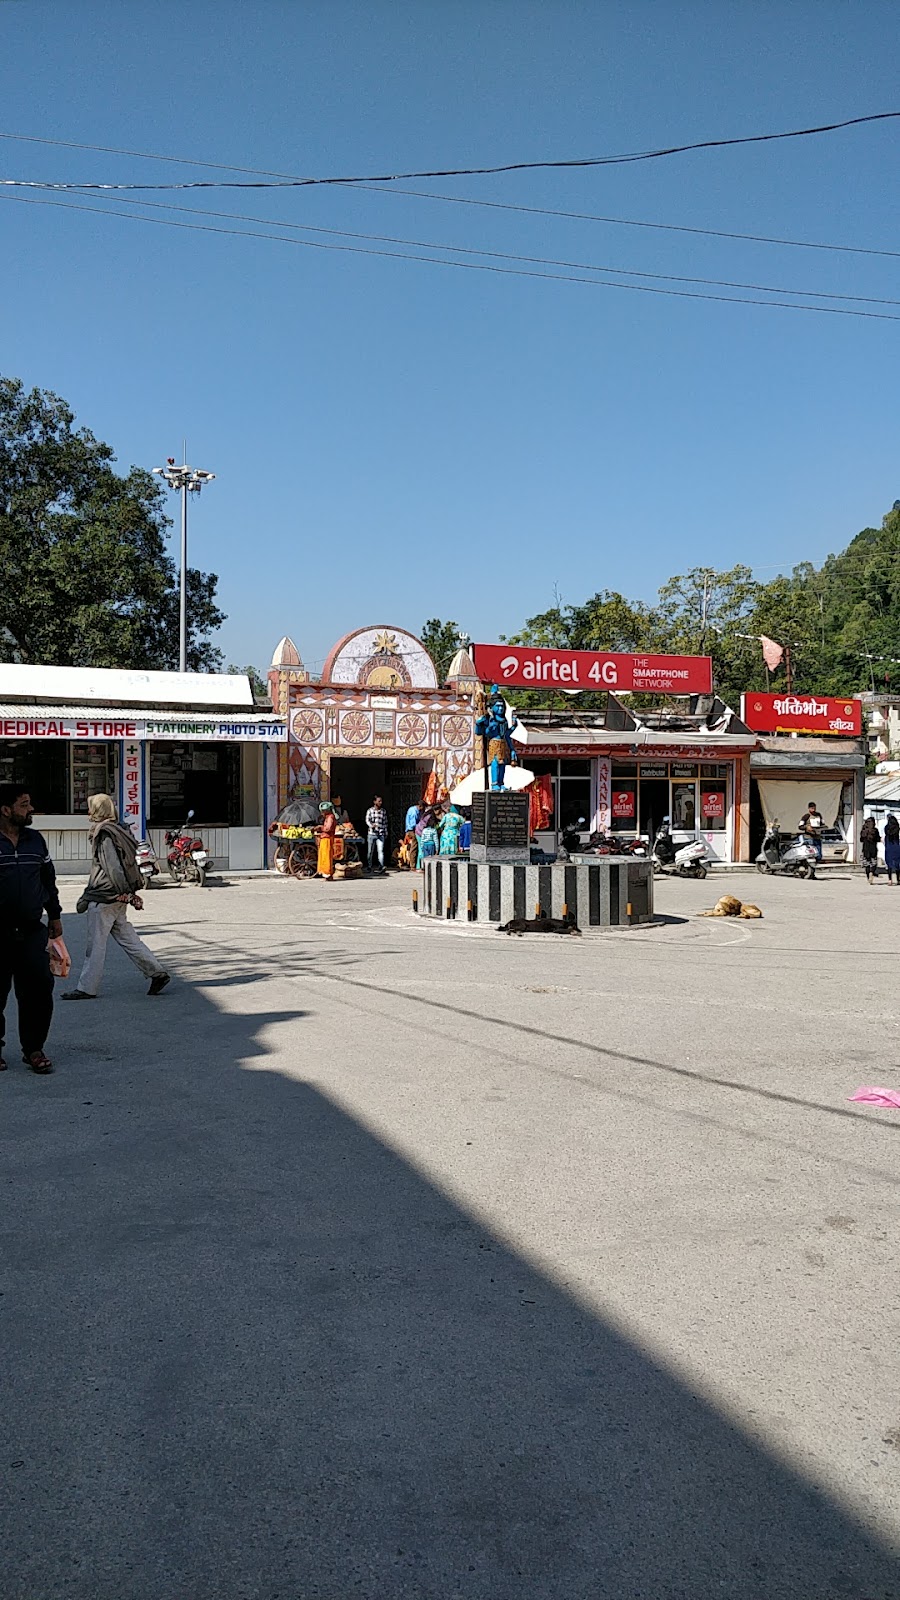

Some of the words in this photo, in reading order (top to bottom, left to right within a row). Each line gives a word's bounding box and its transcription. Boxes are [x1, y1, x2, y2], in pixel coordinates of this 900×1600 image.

[632, 658, 649, 668] THE
[522, 655, 580, 683] airtel
[588, 661, 618, 684] 4G
[632, 668, 689, 679] SMARTPHONE
[632, 678, 674, 688] NETWORK
[76, 722, 137, 737] STORE
[146, 722, 216, 735] STATIONERY
[219, 724, 256, 736] PHOTO
[258, 725, 286, 736] STAT
[613, 802, 633, 810] airtel
[703, 803, 722, 811] airtel
